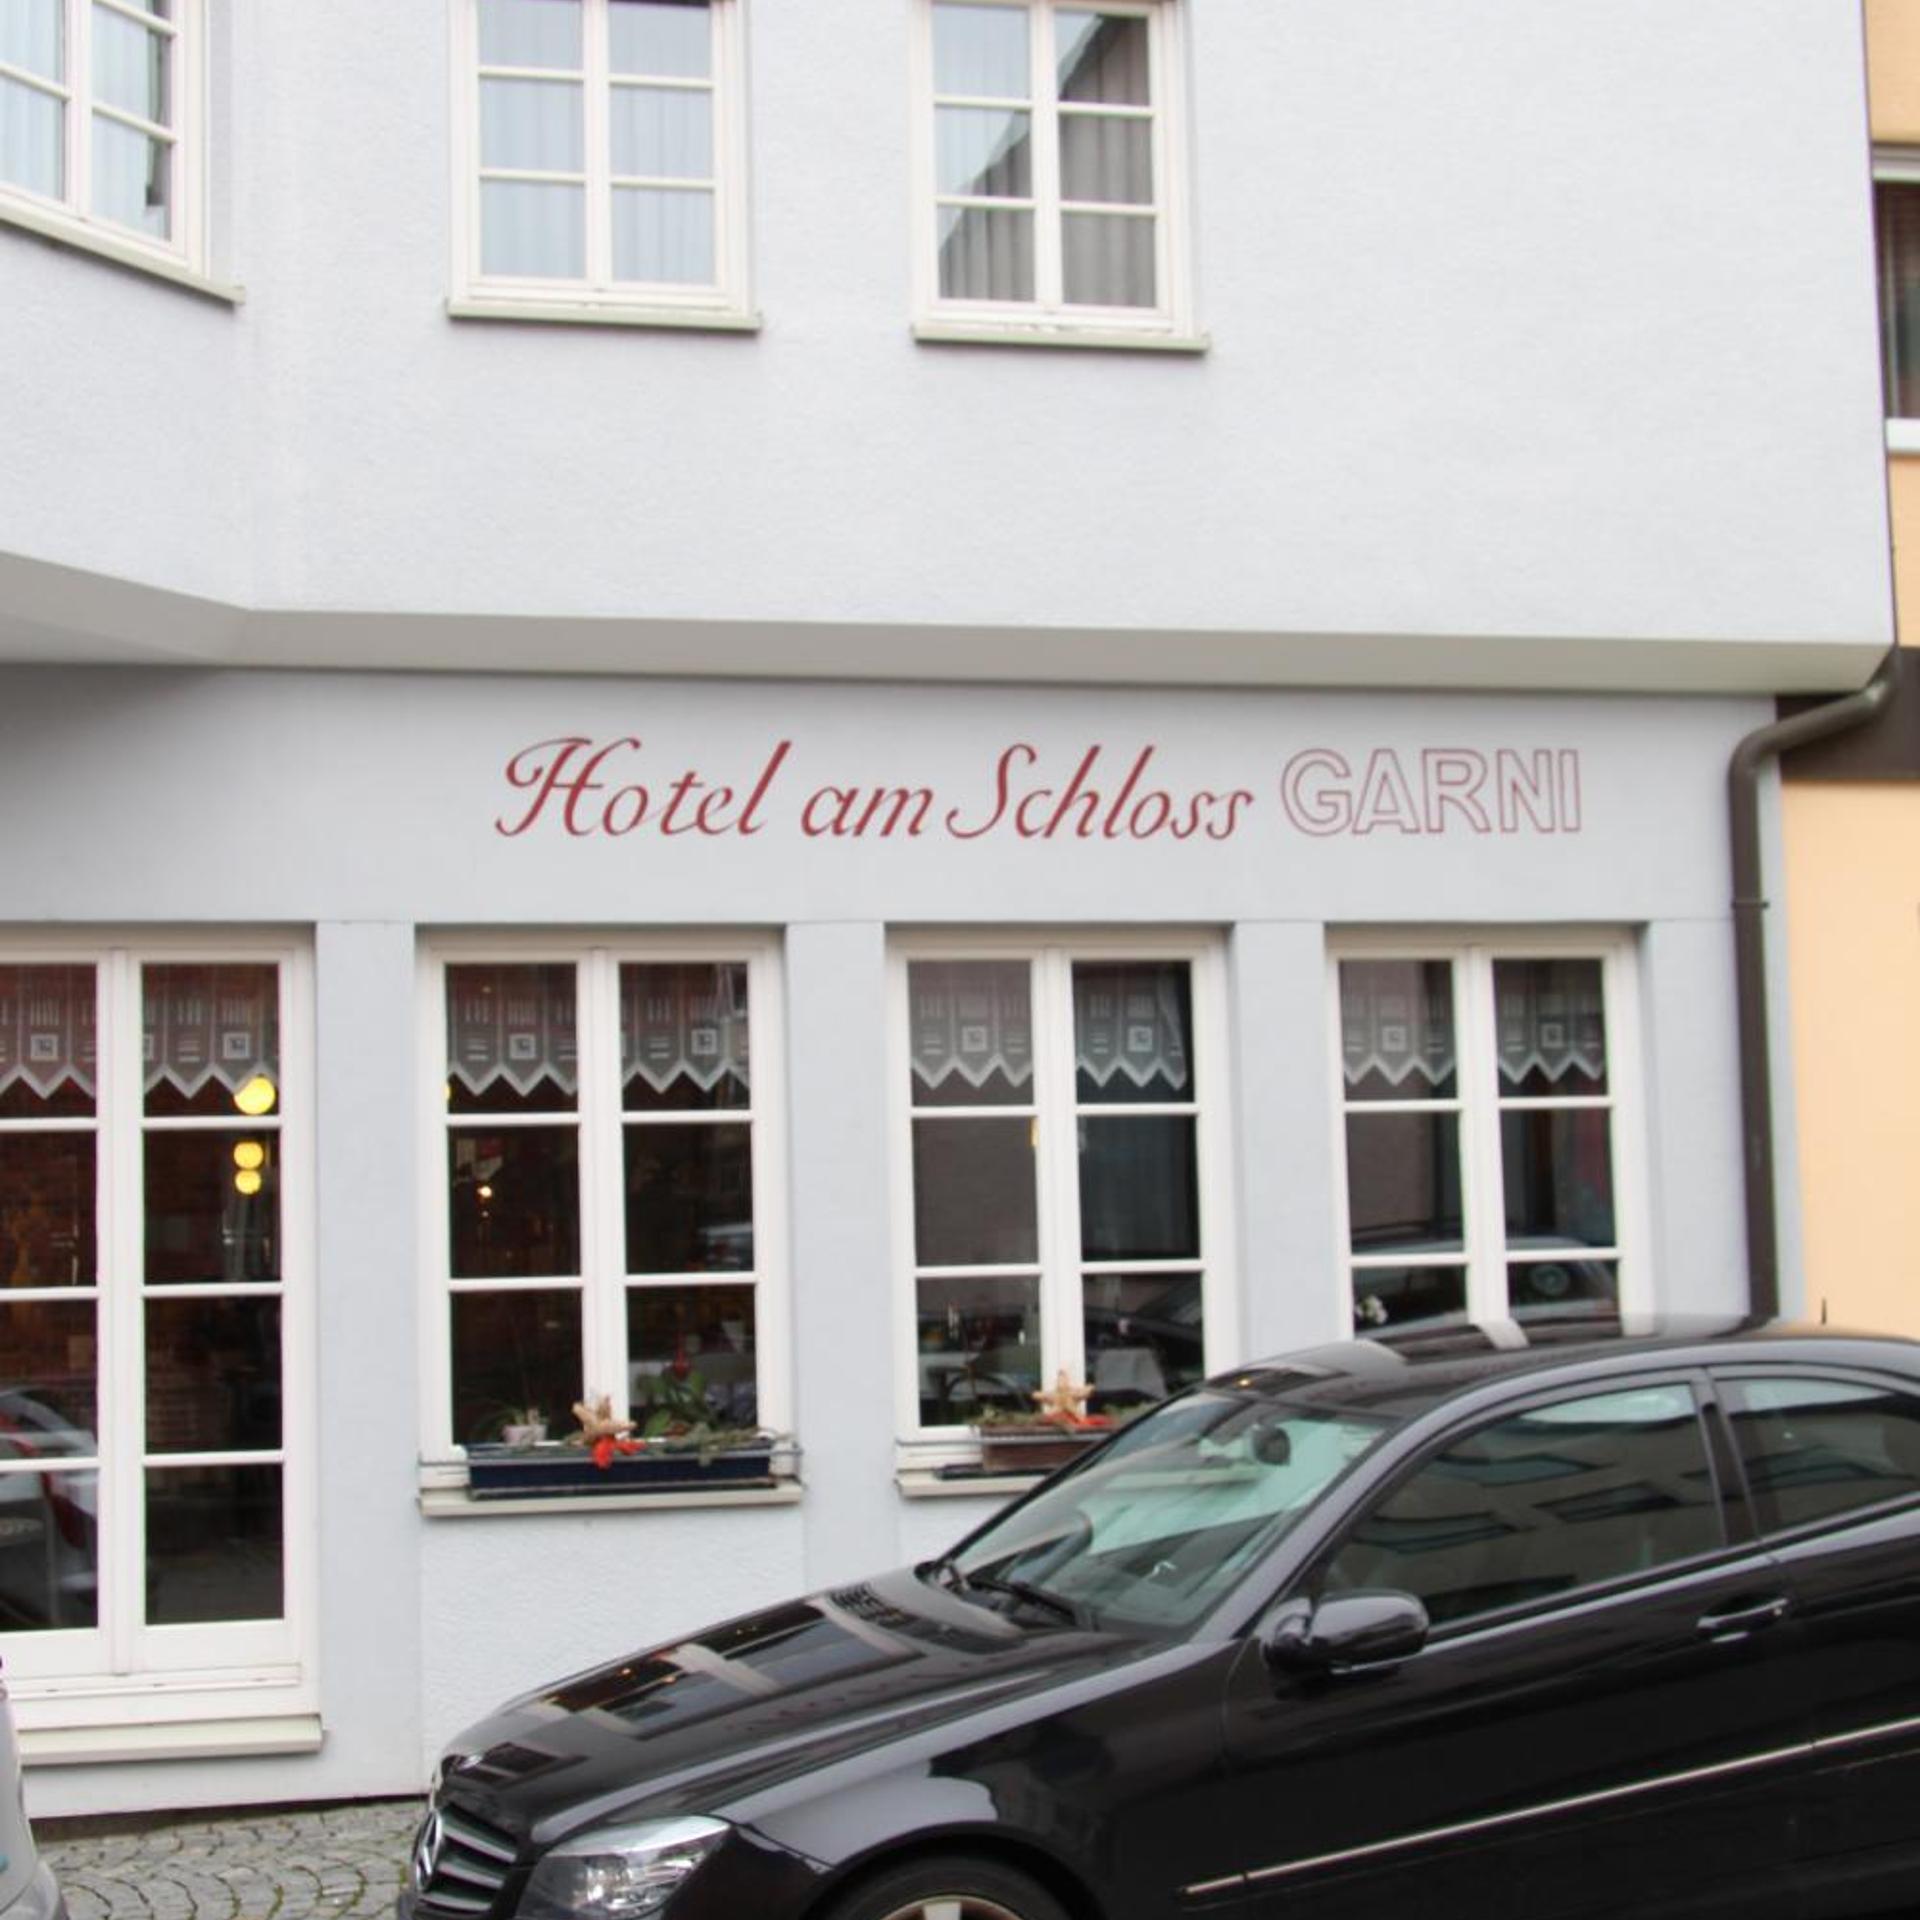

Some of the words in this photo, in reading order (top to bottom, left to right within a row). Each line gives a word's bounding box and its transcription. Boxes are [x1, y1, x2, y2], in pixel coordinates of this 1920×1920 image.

[495, 736, 792, 839] Hotel
[799, 786, 934, 839] am
[946, 743, 1255, 842] Schloss
[1281, 747, 1583, 835] GARNI
